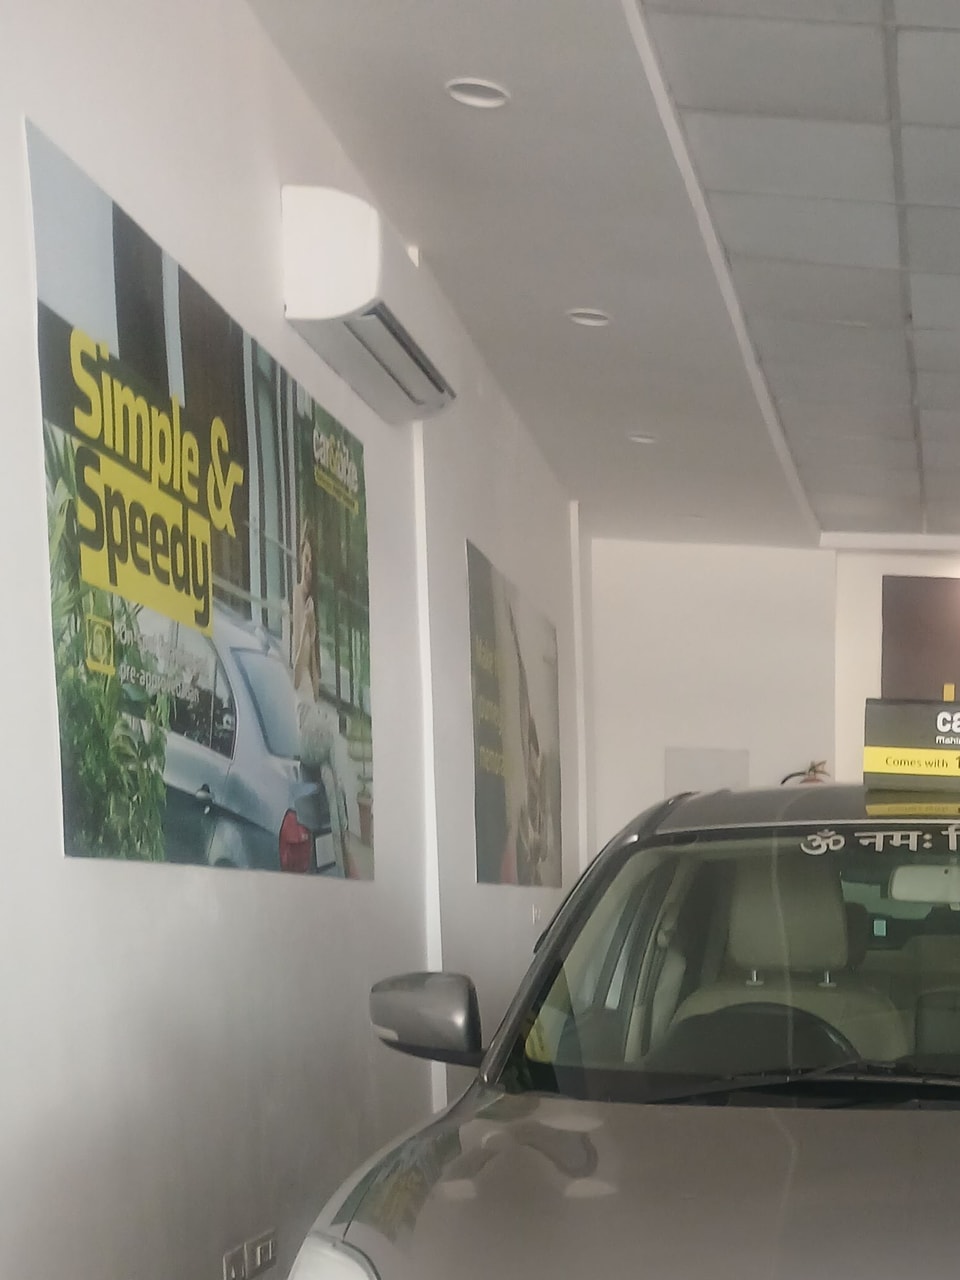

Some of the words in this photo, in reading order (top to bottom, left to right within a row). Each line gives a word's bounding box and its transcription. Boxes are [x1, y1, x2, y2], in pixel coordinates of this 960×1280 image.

[70, 328, 199, 503] Simple
[206, 417, 244, 538] &
[76, 446, 211, 627] Speedy
[885, 756, 922, 768] Comes
[924, 758, 949, 769] with
[854, 830, 933, 853] नमः
